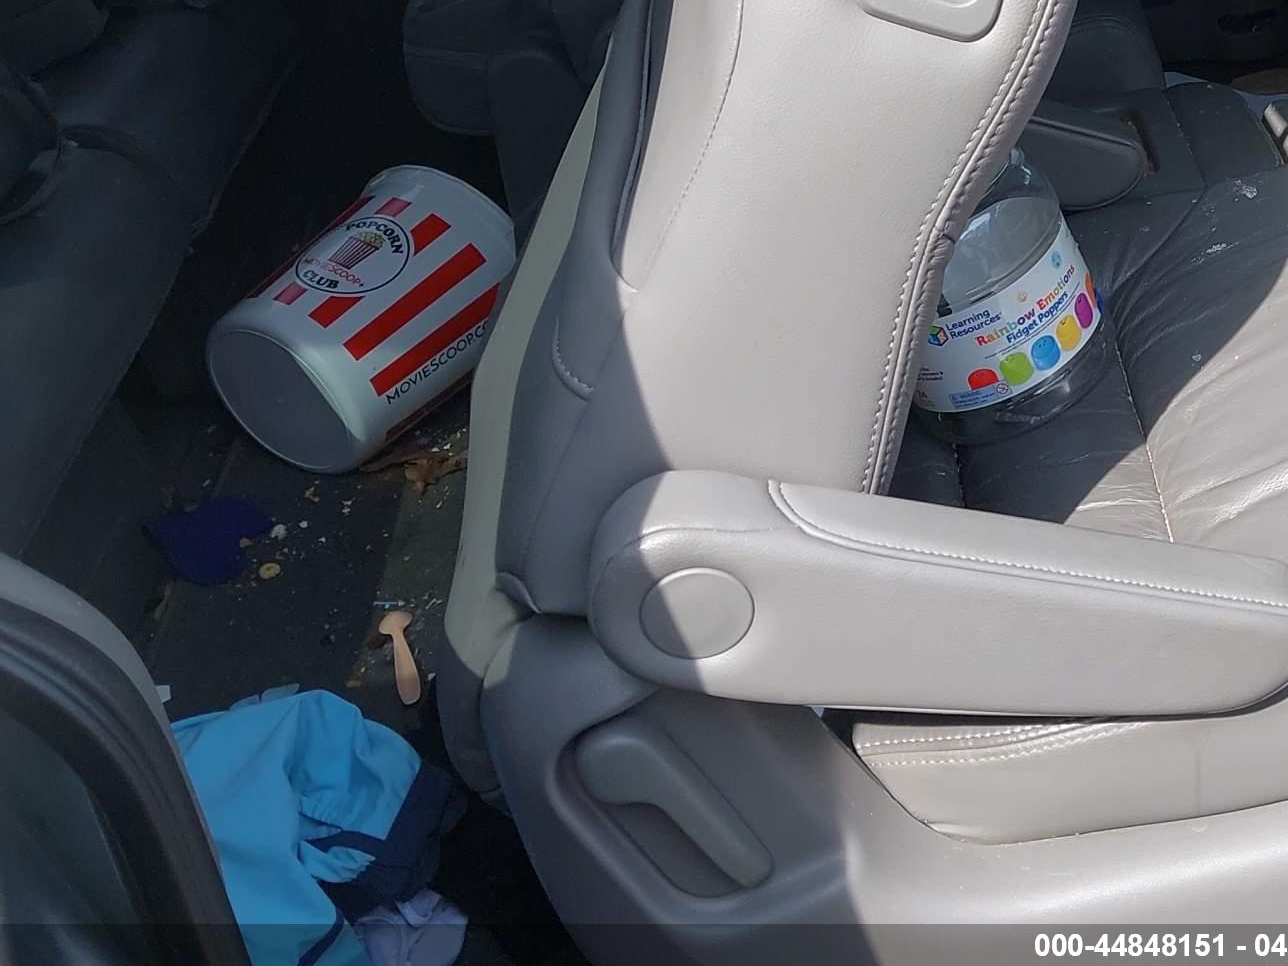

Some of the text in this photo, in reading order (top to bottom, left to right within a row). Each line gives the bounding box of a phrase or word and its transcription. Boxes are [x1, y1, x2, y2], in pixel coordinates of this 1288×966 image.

[345, 220, 404, 254] POPCORN
[302, 269, 340, 289] CLUB
[975, 264, 1075, 346] Rainbow Emotions
[945, 309, 991, 332] Learning
[948, 313, 1001, 340] Resources
[1006, 319, 1039, 344] Fidget
